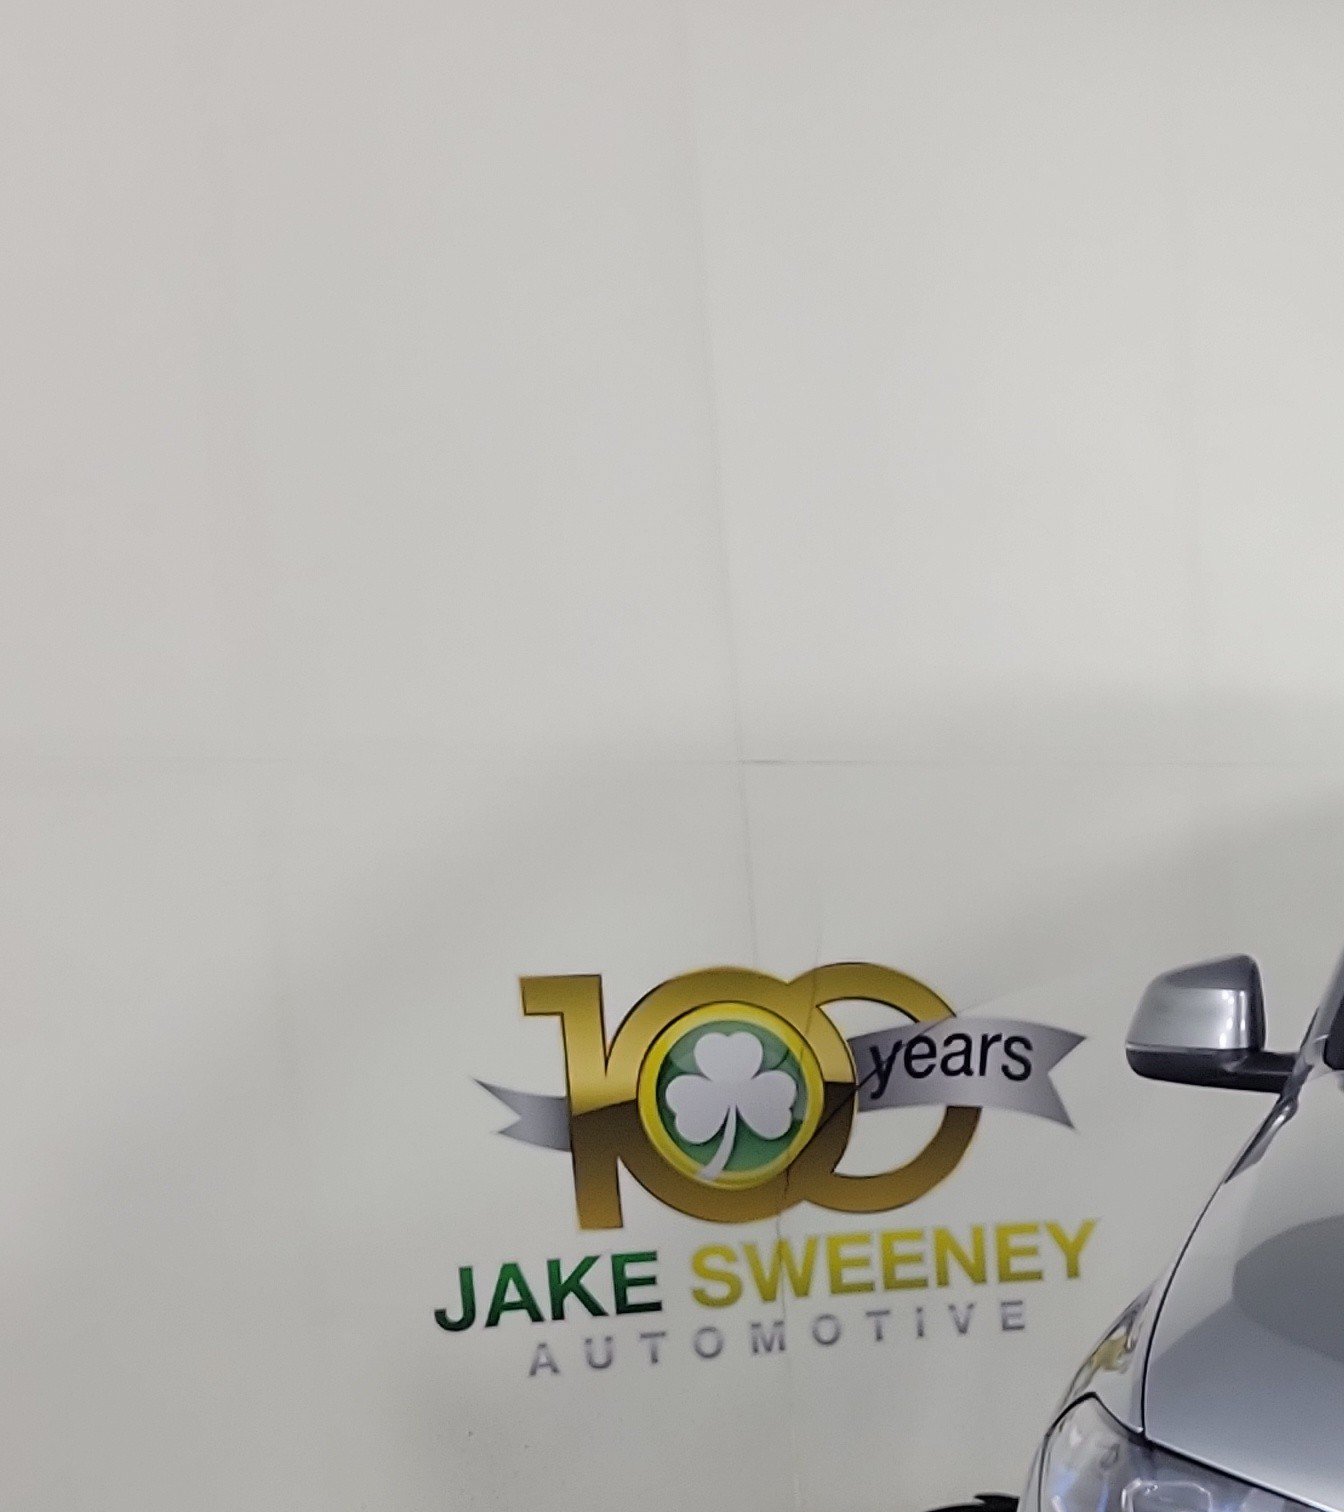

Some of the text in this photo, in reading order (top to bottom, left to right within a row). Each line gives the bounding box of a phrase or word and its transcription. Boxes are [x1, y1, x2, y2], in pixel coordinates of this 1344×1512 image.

[519, 962, 1033, 1231] 100 years
[434, 1218, 1098, 1332] JAKE SWEENEY
[528, 1300, 1027, 1377] AUTOMOTIVE
